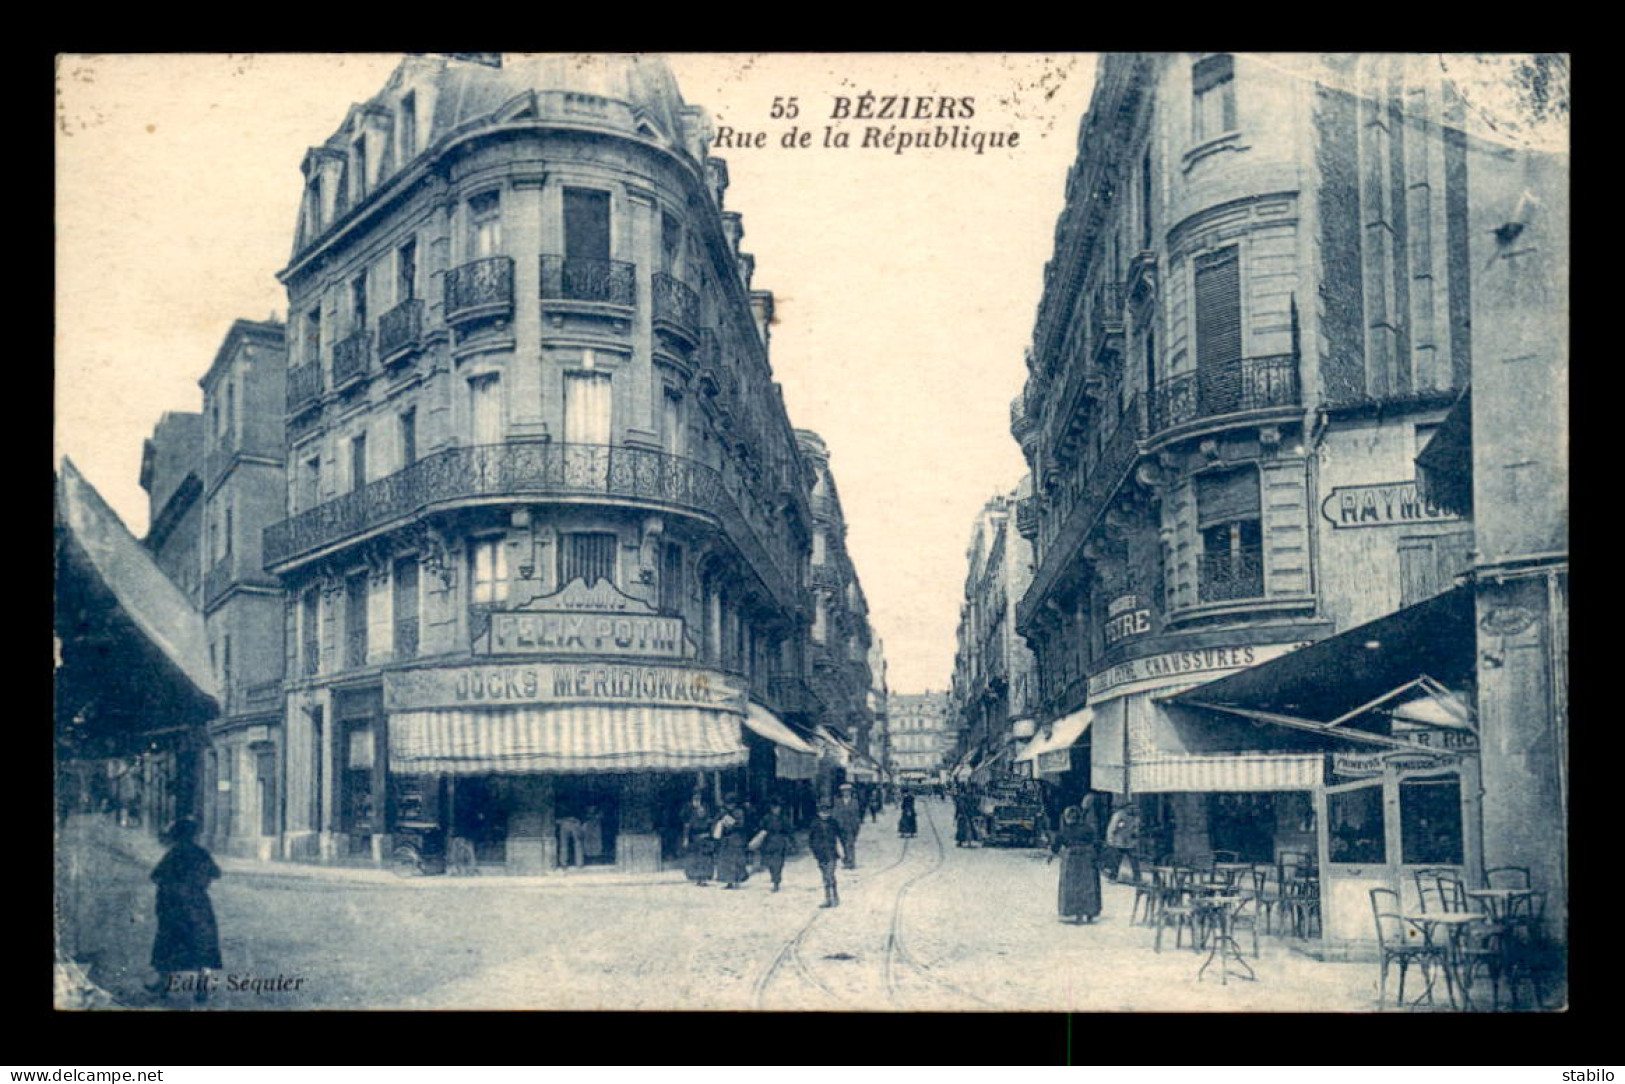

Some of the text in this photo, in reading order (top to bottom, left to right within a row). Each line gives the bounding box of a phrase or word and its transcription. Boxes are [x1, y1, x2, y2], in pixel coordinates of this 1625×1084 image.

[594, 617, 677, 651] POTIN
[1145, 646, 1256, 677] CHAUSSURES
[456, 668, 538, 700] DOCKS
